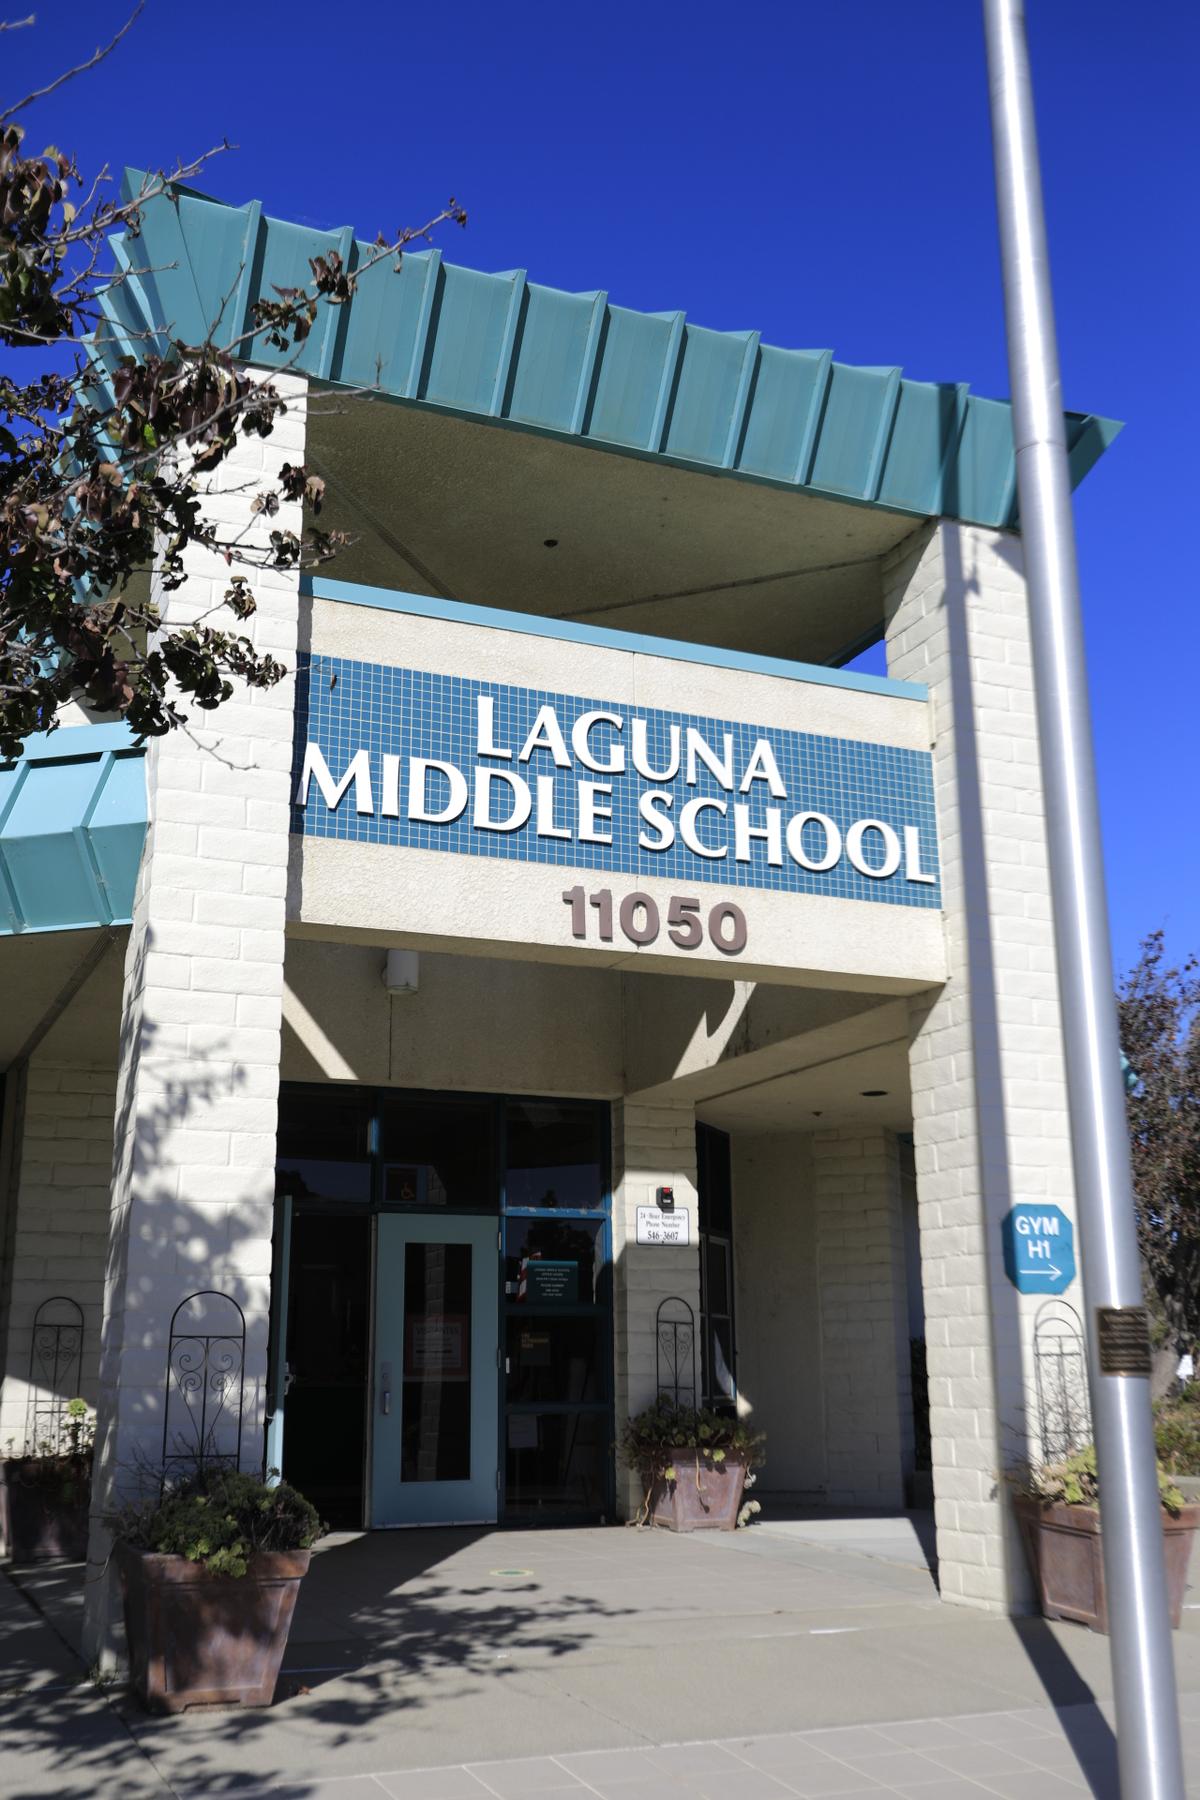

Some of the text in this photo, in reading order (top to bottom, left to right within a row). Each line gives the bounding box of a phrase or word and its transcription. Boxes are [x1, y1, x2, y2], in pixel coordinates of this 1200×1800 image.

[476, 695, 788, 799] LAGUNA
[296, 741, 937, 884] MIDDLE SCHOOL
[562, 885, 748, 954] 11050
[1015, 1215, 1060, 1236] GYM
[1027, 1239, 1051, 1259] H1
